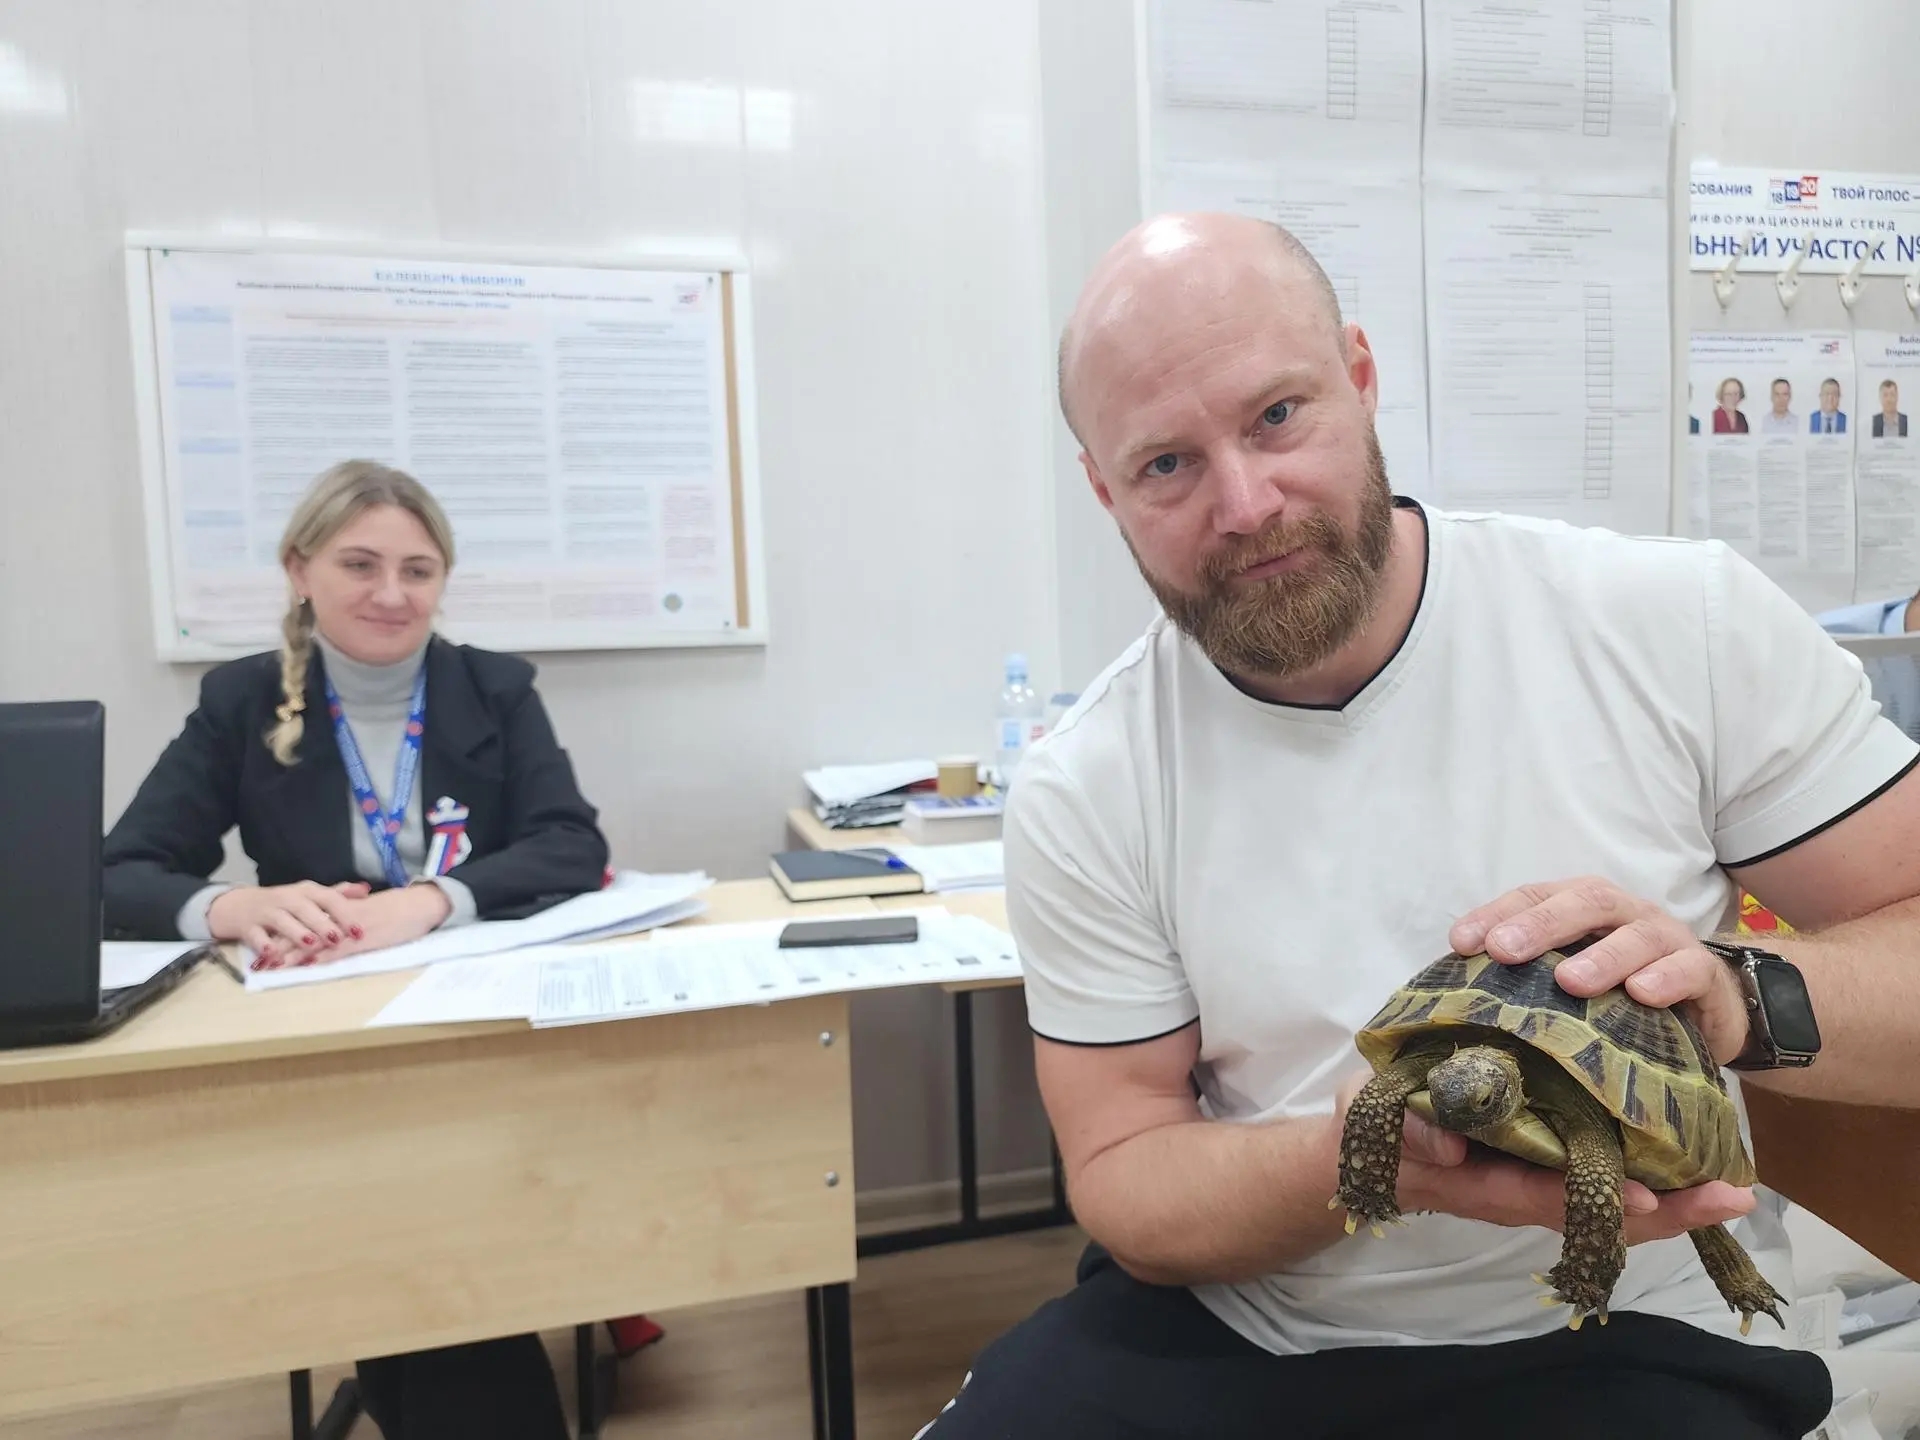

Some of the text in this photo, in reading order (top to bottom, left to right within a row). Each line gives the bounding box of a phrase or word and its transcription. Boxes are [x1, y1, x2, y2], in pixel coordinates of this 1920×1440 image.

[1832, 185, 1865, 200] ТВОЙ
[1869, 189, 1911, 202] ГОЛОС
[1850, 219, 1896, 232] СТЕНД
[1690, 232, 1767, 258] ЬНЫЙ
[1776, 237, 1886, 262] УЧАСТОК
